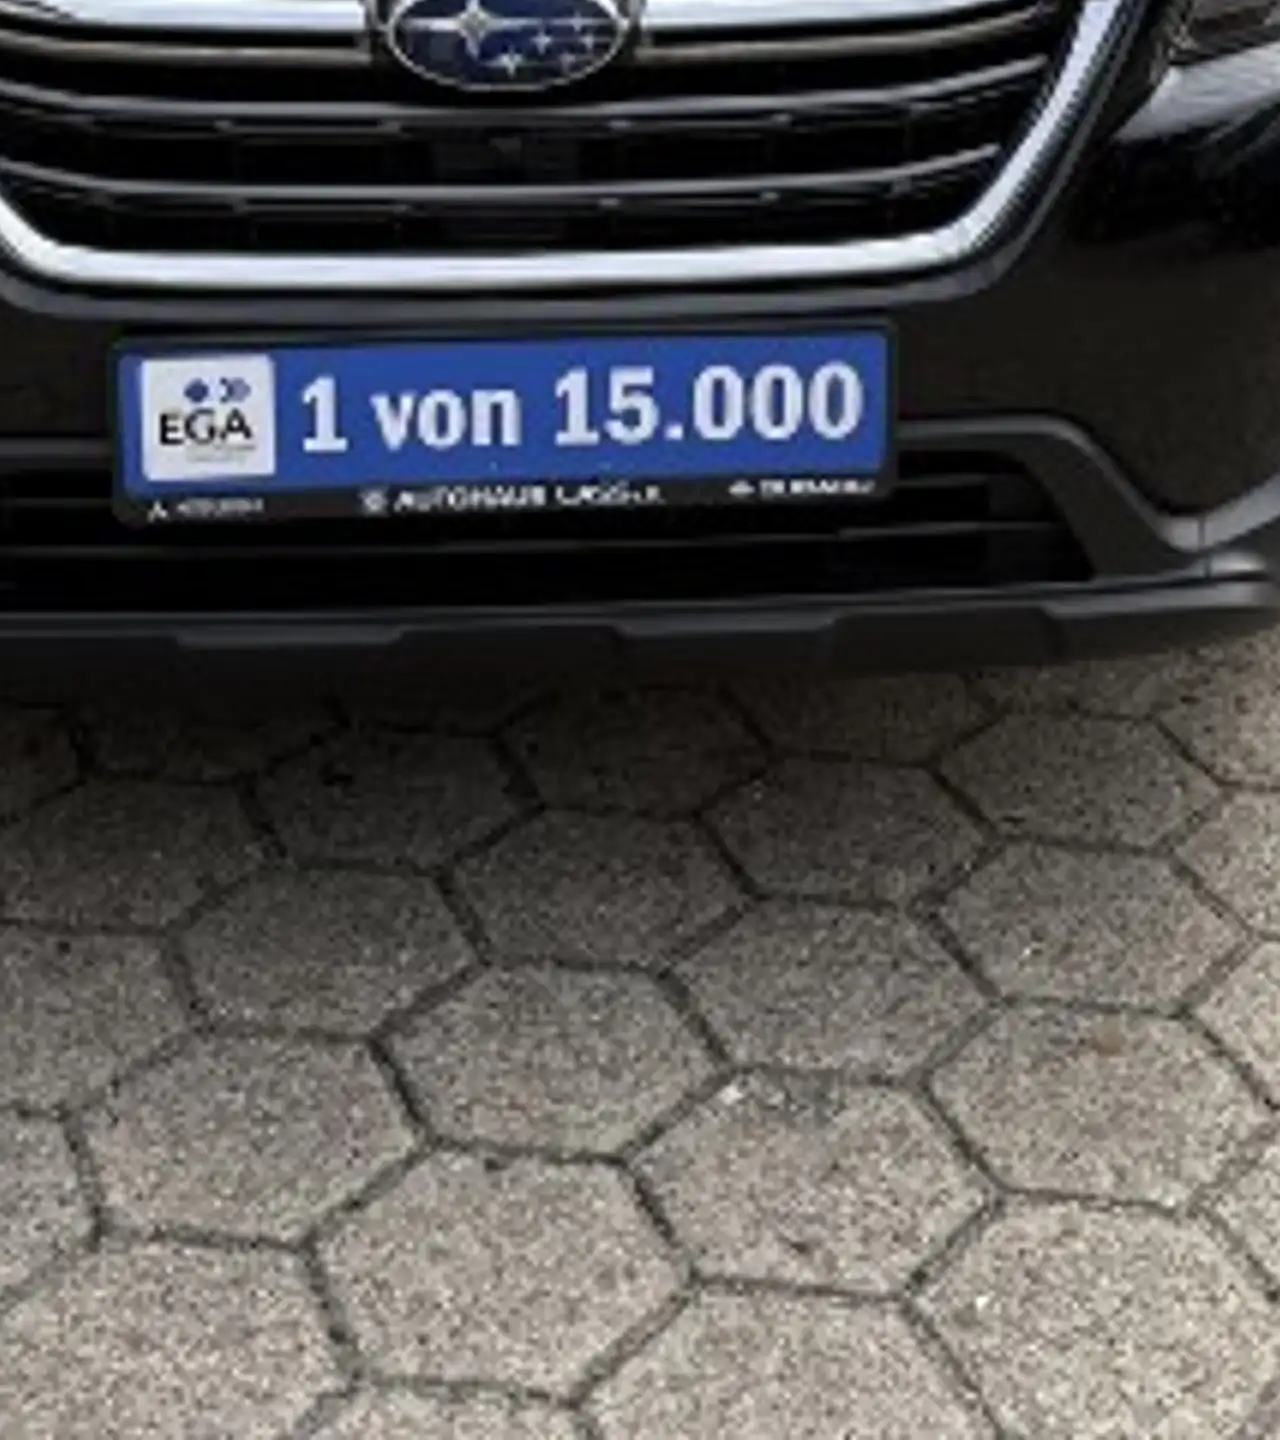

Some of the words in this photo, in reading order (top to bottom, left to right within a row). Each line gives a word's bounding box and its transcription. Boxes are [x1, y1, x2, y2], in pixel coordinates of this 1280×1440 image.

[160, 408, 253, 445] EGA
[302, 377, 348, 453] 1
[371, 388, 521, 449] von
[554, 363, 864, 447] 15.000
